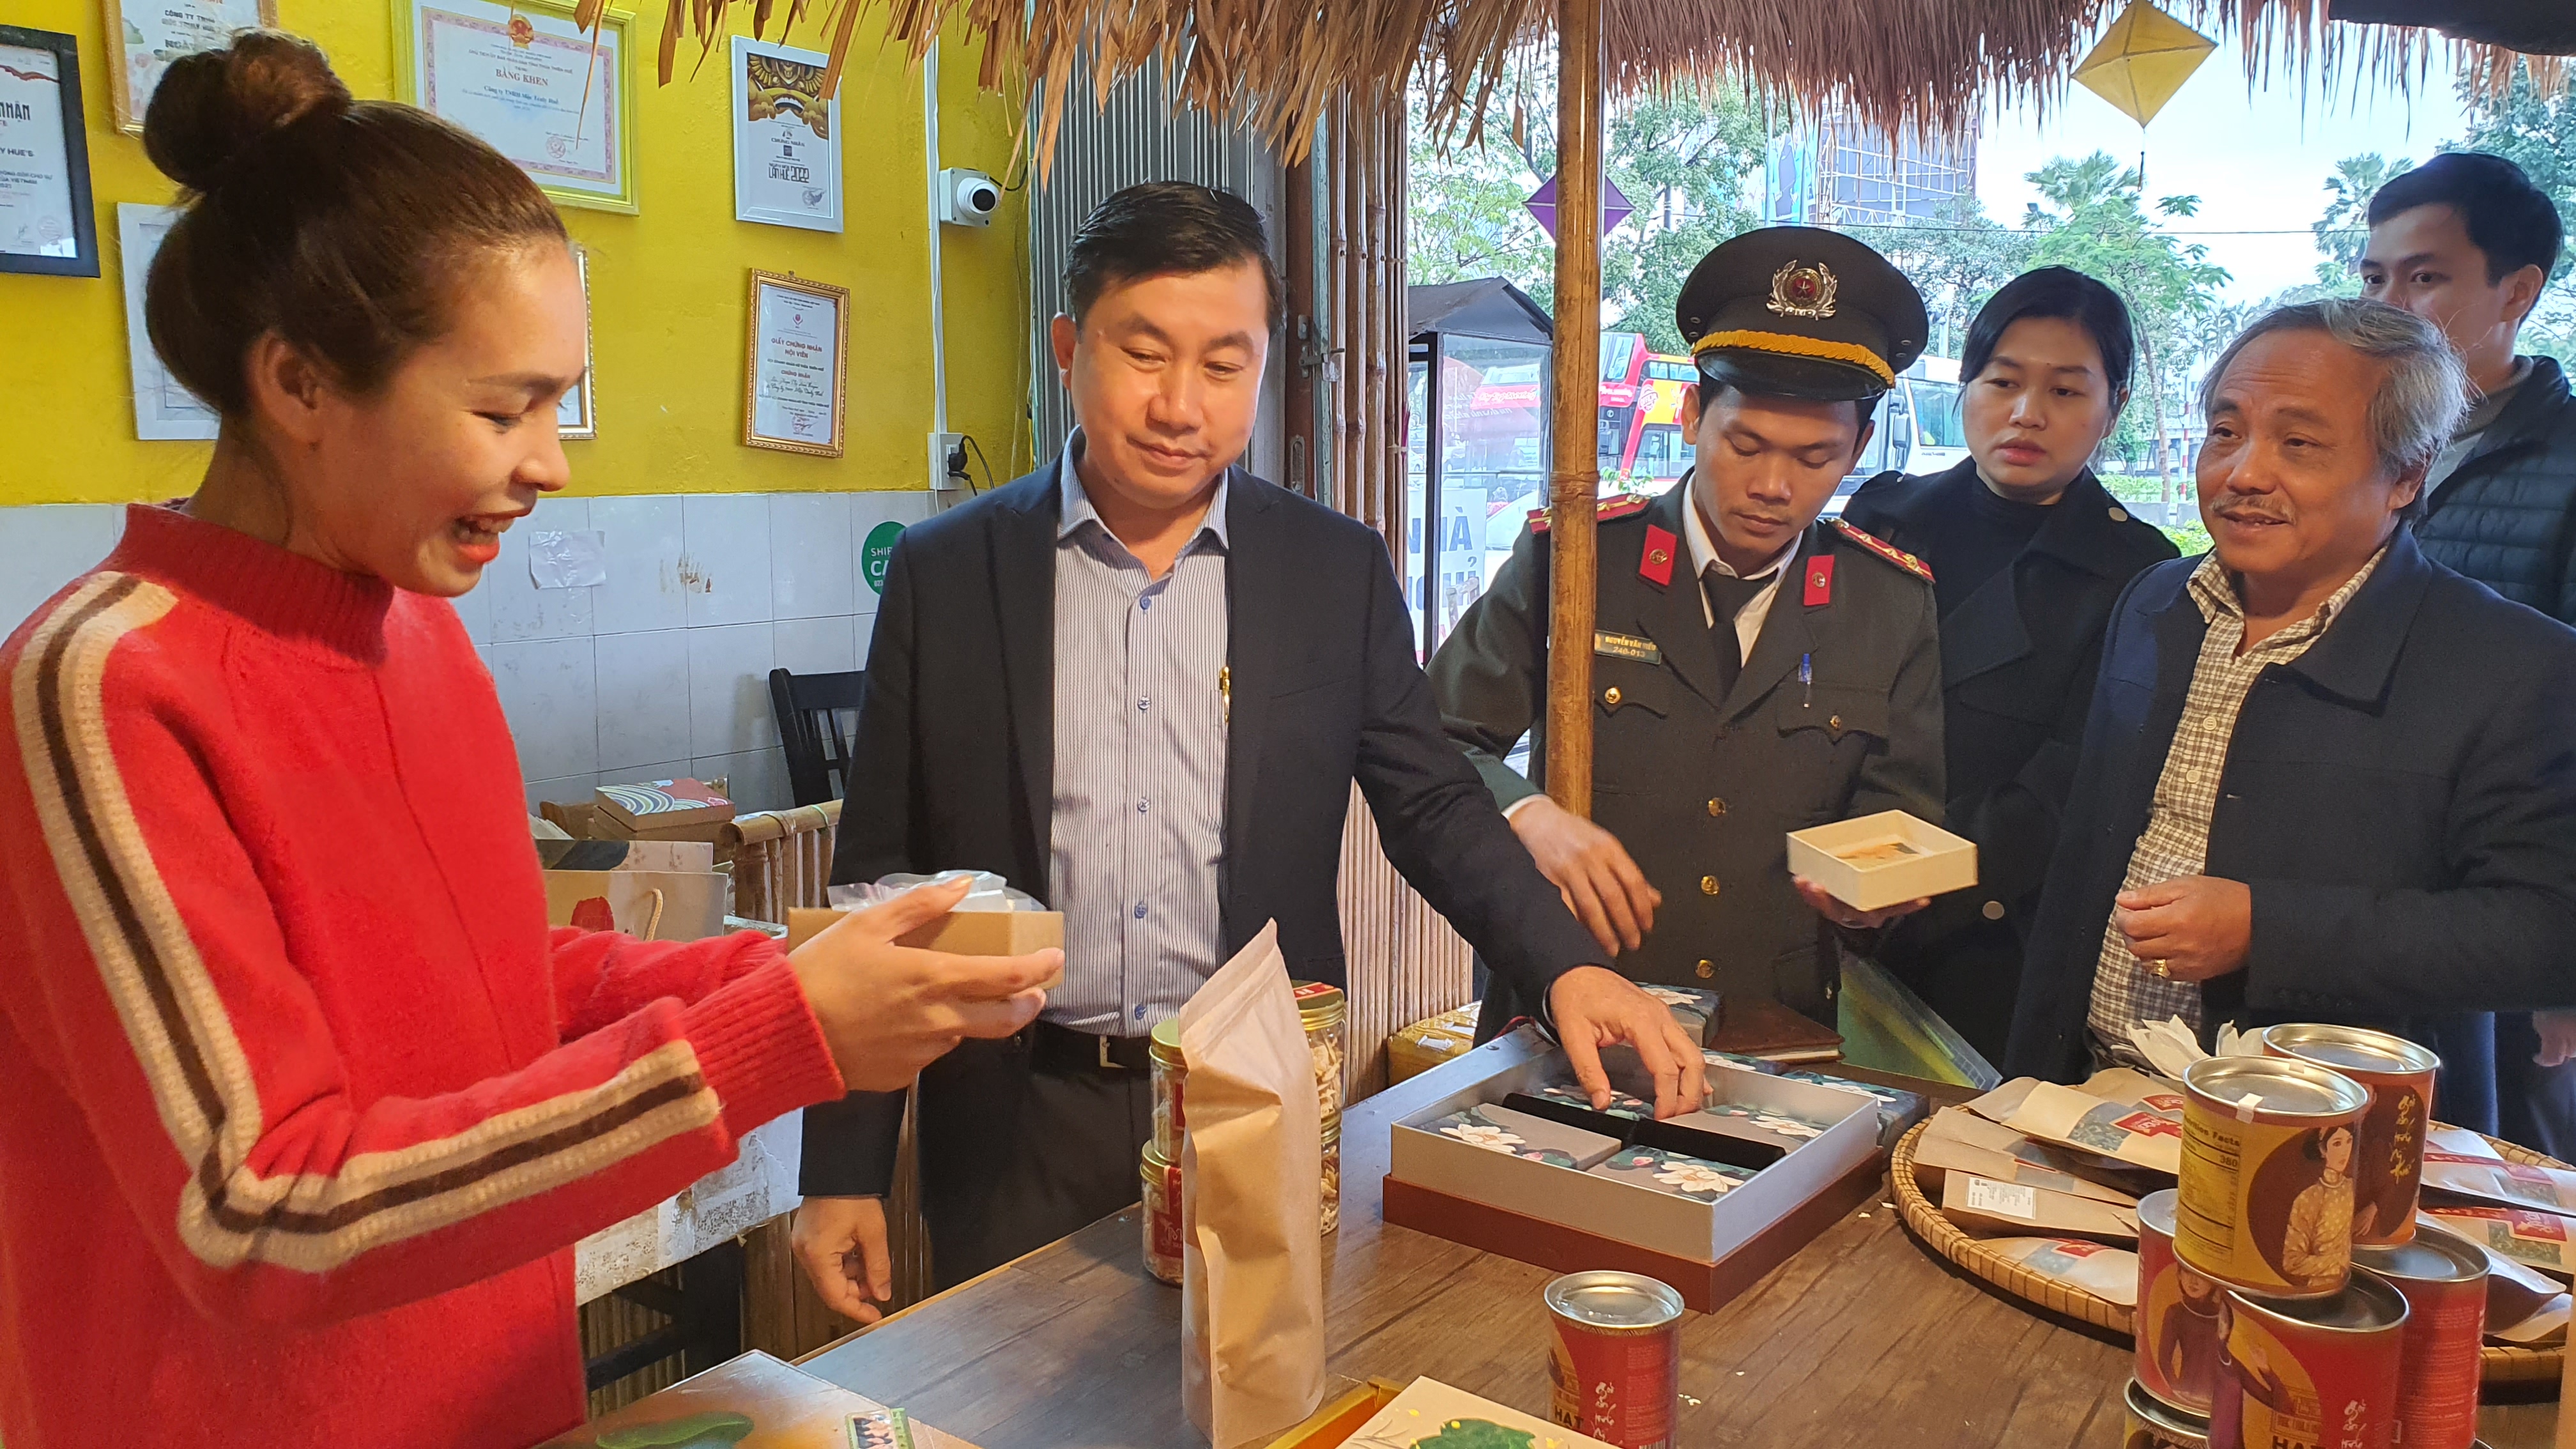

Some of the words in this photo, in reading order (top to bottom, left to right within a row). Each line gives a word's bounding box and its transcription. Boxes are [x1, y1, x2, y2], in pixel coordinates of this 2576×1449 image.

[523, 74, 548, 86] KHEN
[2212, 1131, 2240, 1147] Facts
[2219, 1154, 2238, 1168] 380
